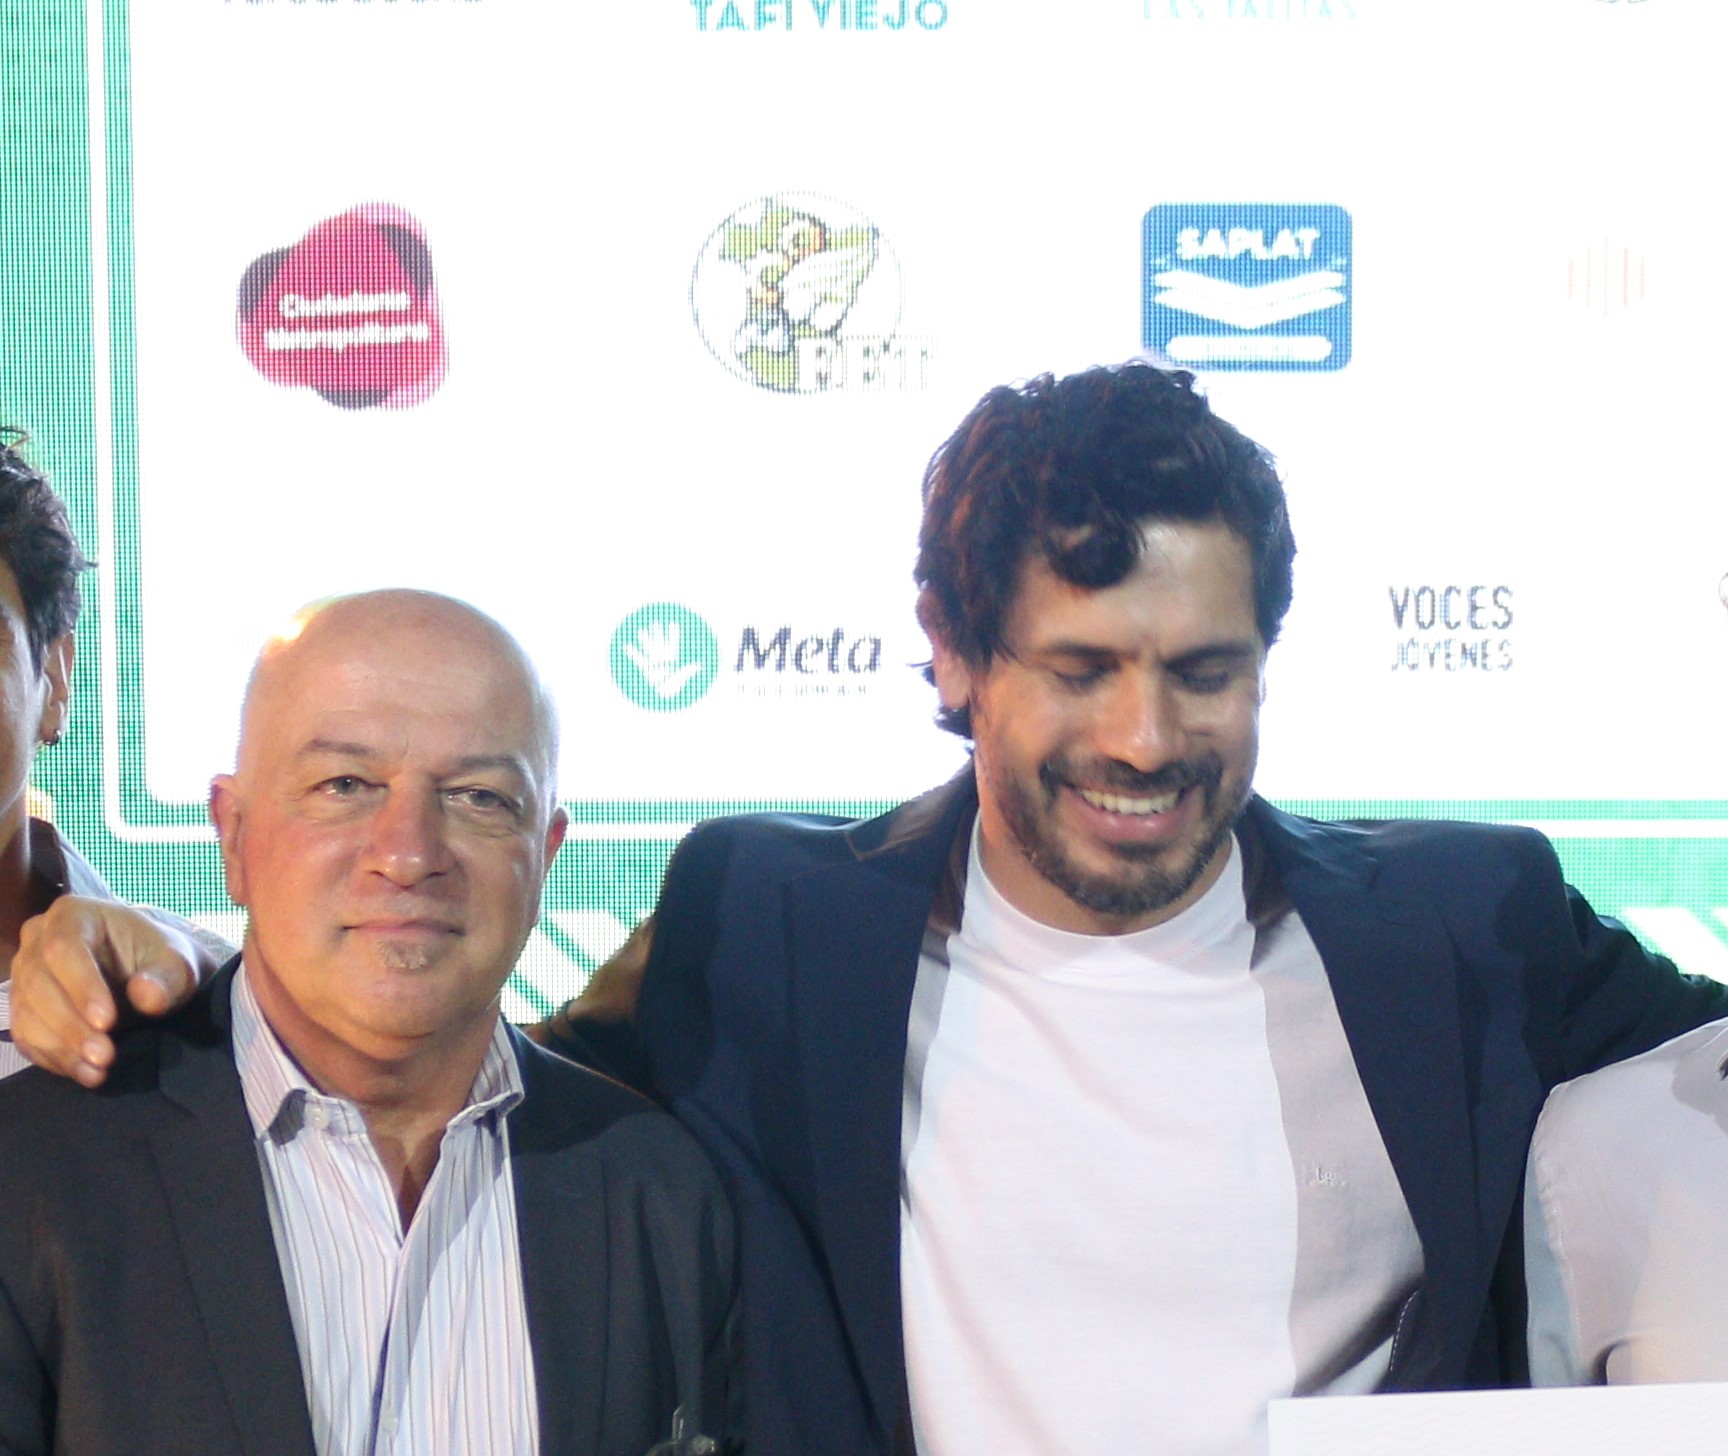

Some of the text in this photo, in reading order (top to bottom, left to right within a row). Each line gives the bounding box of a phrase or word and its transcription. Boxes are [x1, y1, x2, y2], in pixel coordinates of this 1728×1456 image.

[808, 0, 948, 31] VIEJO
[1176, 226, 1320, 261] SAPLAT
[1388, 585, 1513, 630] VOCES
[733, 623, 881, 674] Meta
